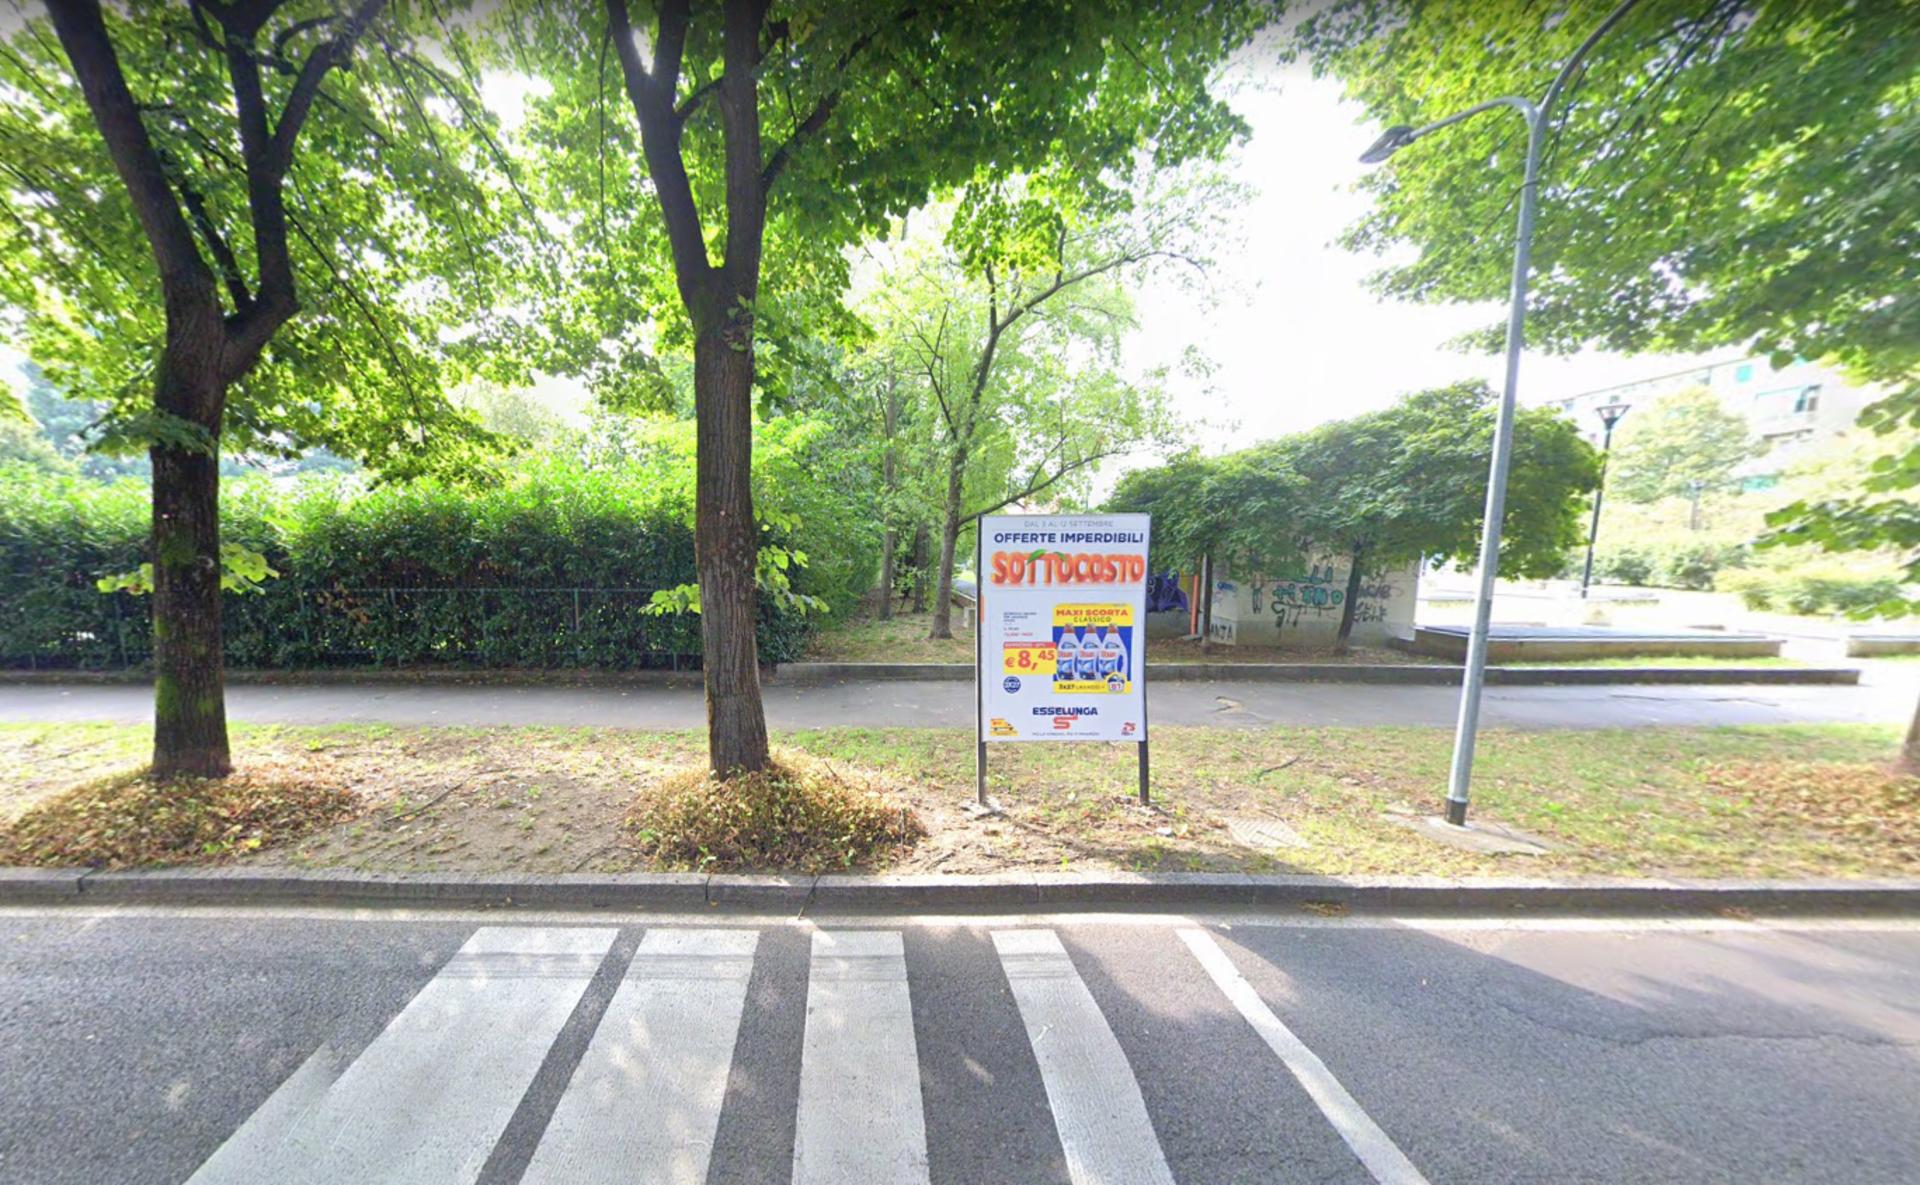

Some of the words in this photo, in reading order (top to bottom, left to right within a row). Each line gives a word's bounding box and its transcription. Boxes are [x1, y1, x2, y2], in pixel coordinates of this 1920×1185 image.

[1069, 520, 1113, 528] SETTEMBRE
[994, 533, 1057, 544] OFFERTE
[1060, 533, 1144, 543] IMPERDIBILI
[991, 550, 1145, 585] SOTTOCOSTO
[1056, 609, 1084, 617] MAXI
[1086, 609, 1128, 617] SCORTA
[1005, 657, 1015, 668] €
[1032, 707, 1098, 716] ESSELUNGA
